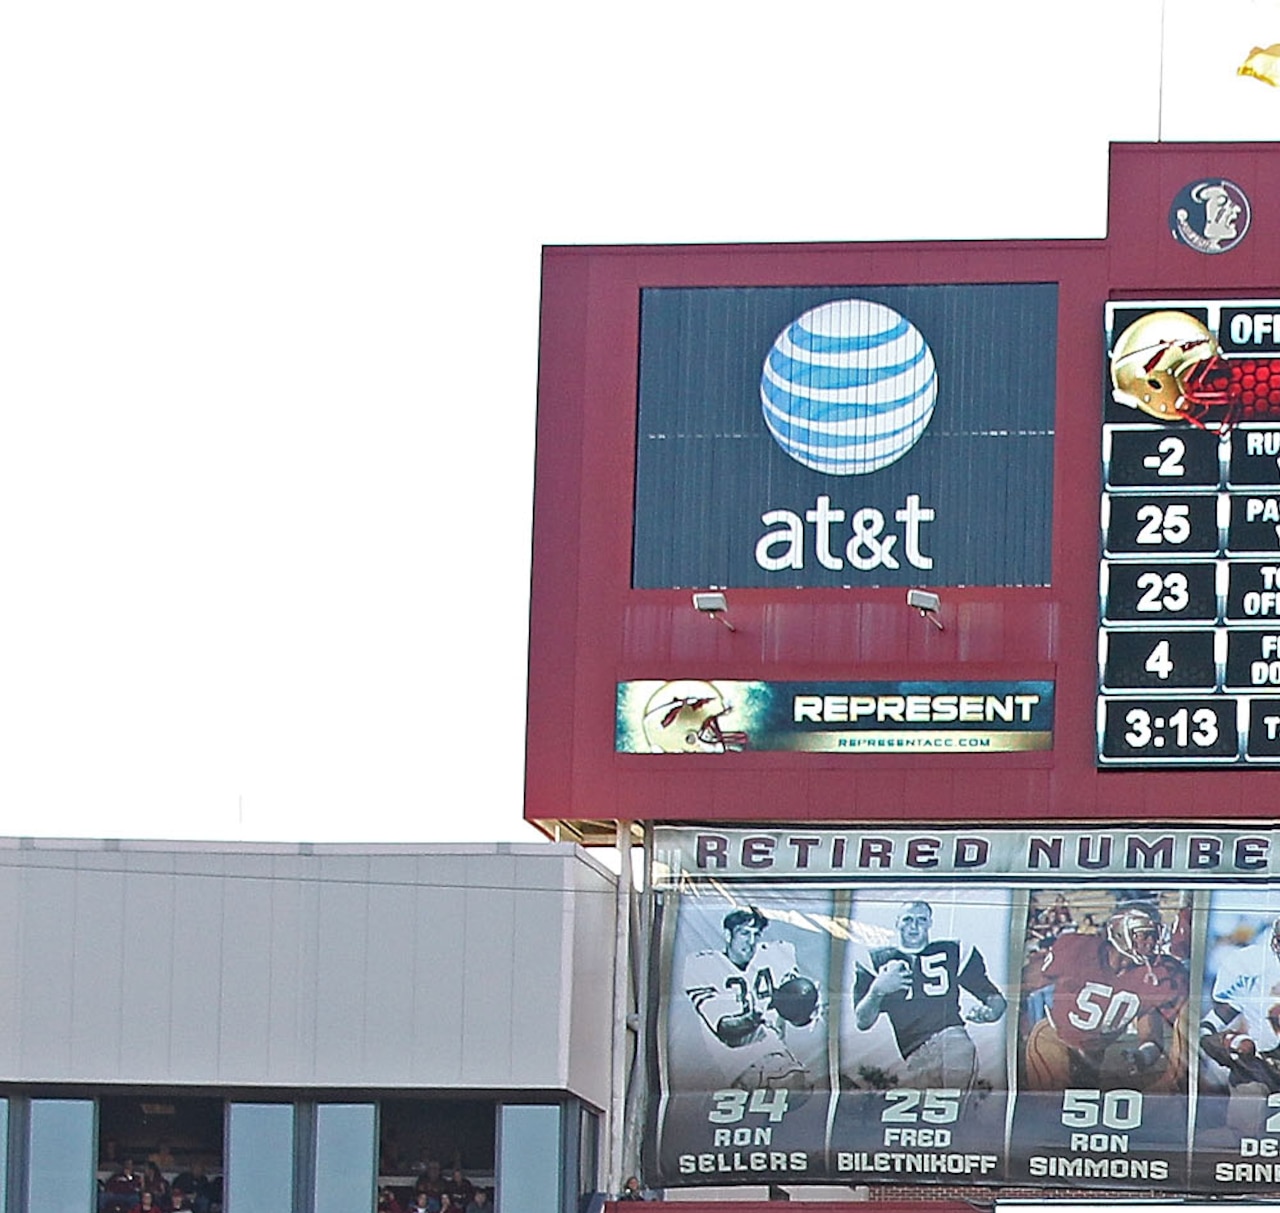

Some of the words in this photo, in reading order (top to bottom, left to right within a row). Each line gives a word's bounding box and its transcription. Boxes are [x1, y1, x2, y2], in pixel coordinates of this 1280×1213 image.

[1142, 436, 1186, 477] -2
[754, 494, 937, 571] at&t
[1136, 504, 1192, 545] 25
[1136, 571, 1190, 612] 23
[1145, 640, 1174, 679] 4
[792, 694, 1041, 724] REPRESENT
[837, 737, 992, 748] REPRESENTACC.COM
[1124, 707, 1219, 749] 3:13
[694, 834, 992, 871] RETIRED
[1068, 981, 1141, 1031] 50
[708, 1089, 789, 1124] 34
[880, 1088, 963, 1124] 25
[1060, 1088, 1145, 1129] 50
[714, 1127, 772, 1148] RON
[883, 1128, 952, 1149] FRED
[1069, 1133, 1130, 1154] RON
[678, 1152, 808, 1174] SELLERS
[837, 1152, 998, 1175] BILETNIKOFF
[1029, 1156, 1169, 1181] SIMMONS
